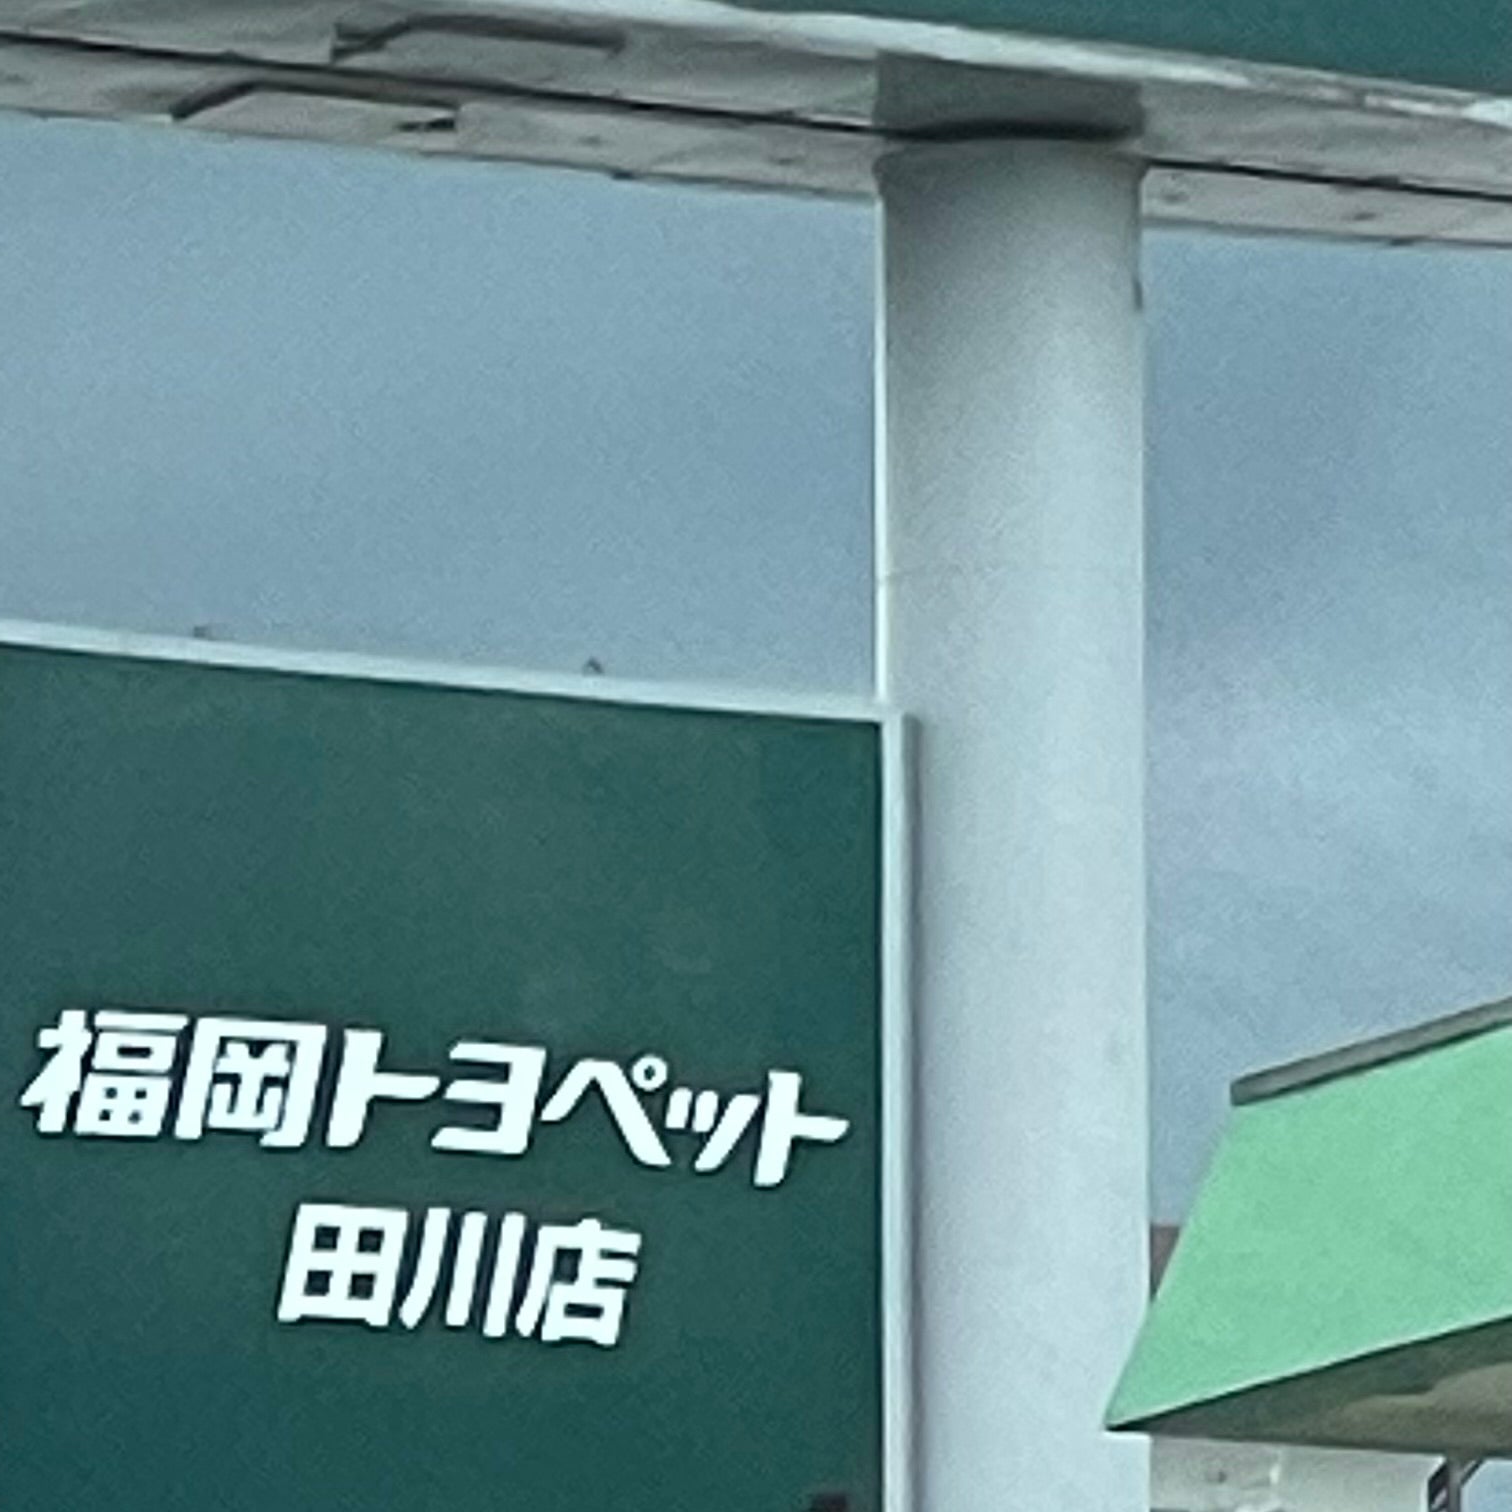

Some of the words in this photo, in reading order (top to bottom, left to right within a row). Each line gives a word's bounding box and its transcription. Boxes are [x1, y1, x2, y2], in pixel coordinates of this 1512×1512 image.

[20, 1009, 850, 1187] 福岡トヨペット
[277, 1202, 642, 1346] 田川店
